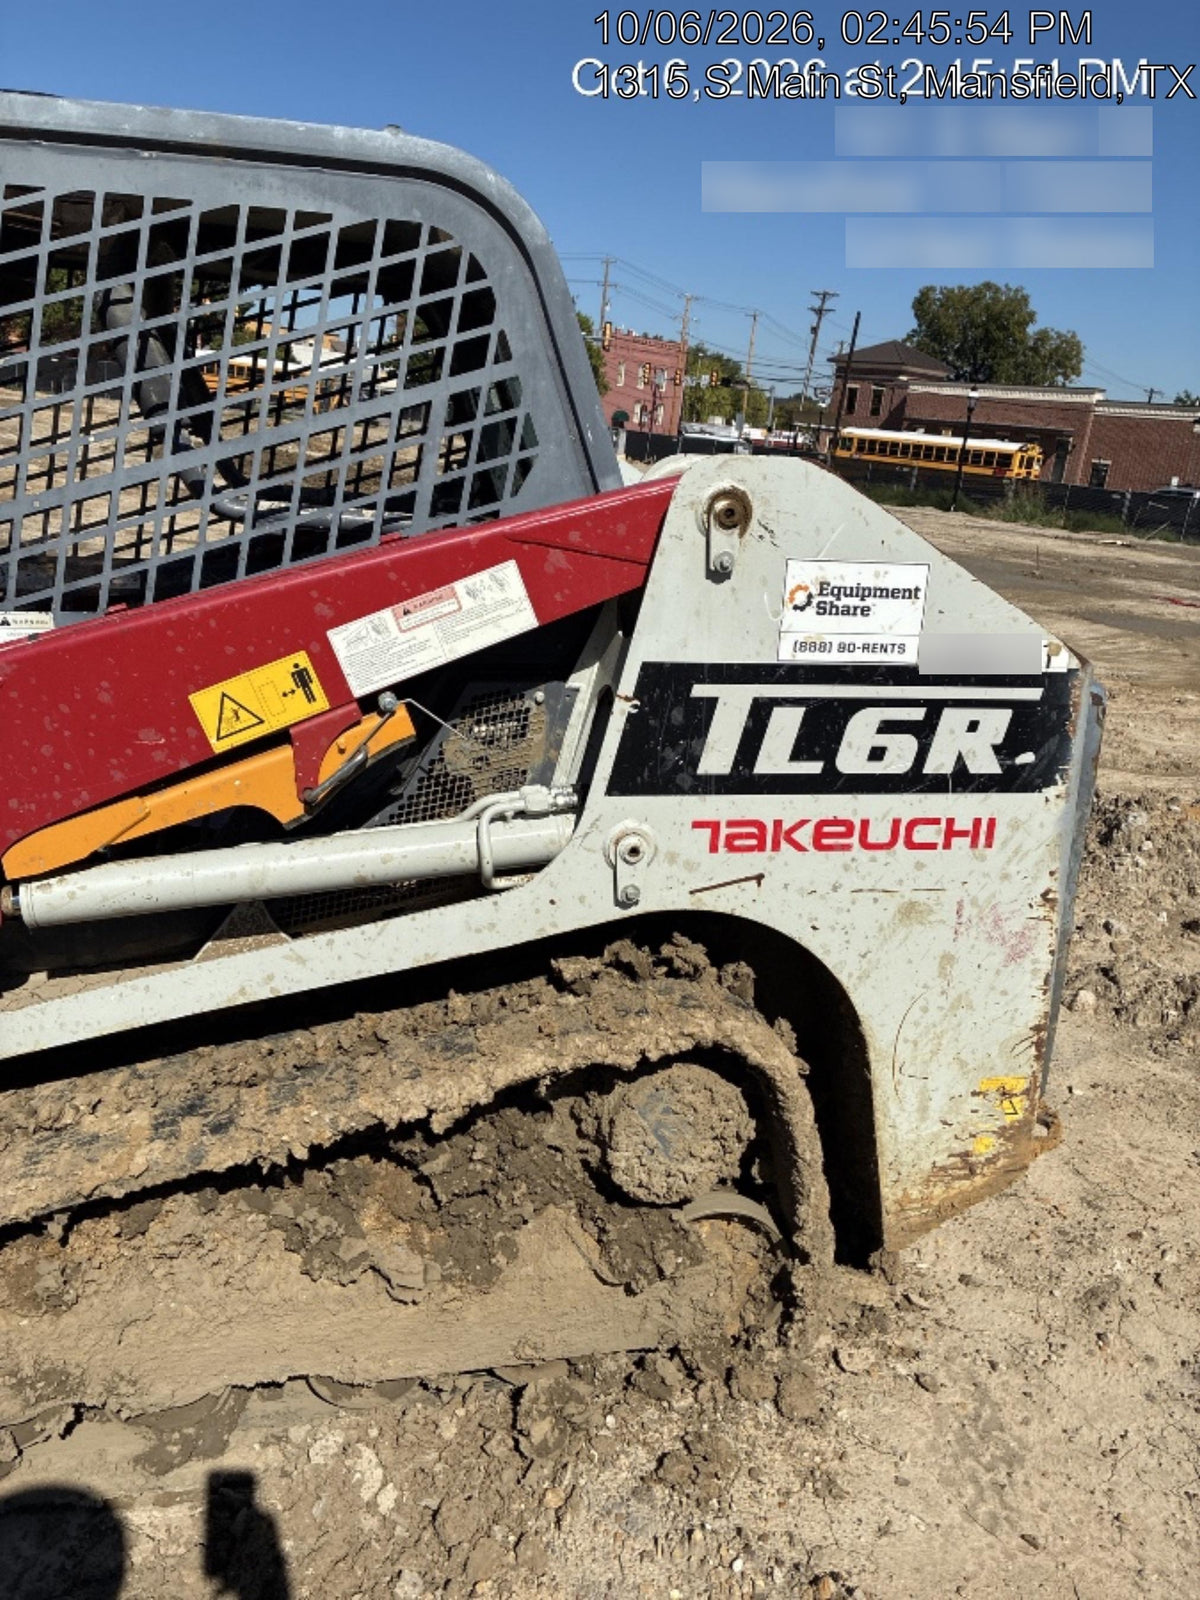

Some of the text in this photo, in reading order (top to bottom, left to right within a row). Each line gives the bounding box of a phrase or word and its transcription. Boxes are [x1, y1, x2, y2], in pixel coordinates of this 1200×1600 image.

[817, 581, 921, 601] Equipment
[815, 600, 872, 617] Share
[792, 640, 833, 654] (888)
[690, 683, 1044, 775] TL6R
